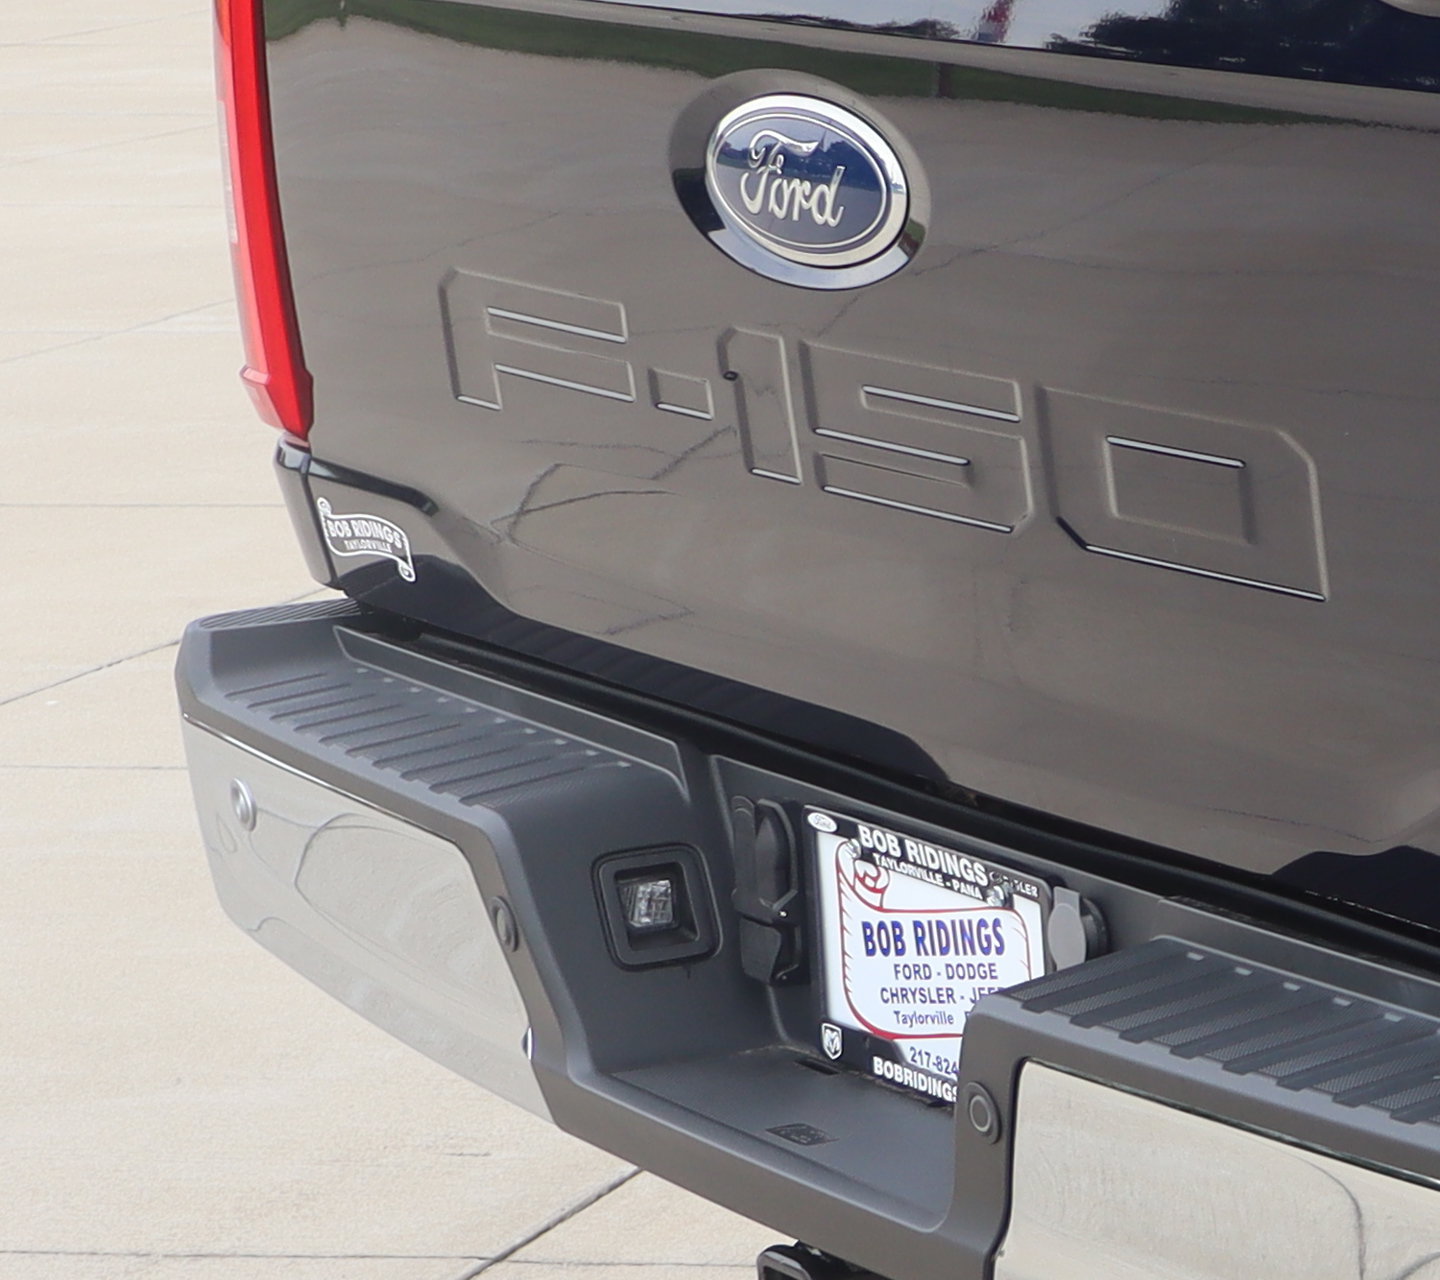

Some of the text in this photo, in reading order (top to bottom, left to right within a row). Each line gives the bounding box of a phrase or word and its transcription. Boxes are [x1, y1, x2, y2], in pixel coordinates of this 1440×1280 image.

[740, 129, 845, 227] Ford
[440, 267, 1328, 602] F-150
[326, 519, 402, 548] BOB RIDINGS
[344, 539, 392, 553] TAYLORVILLE
[857, 824, 901, 856] BOB
[905, 839, 988, 887] RIDINGS
[873, 853, 945, 887] TAYLORVILLE
[952, 878, 983, 900] PANA
[861, 918, 1005, 957] BOB RIDINGS
[894, 963, 932, 981] FORD
[945, 963, 998, 980] DODGE
[880, 987, 957, 1004] CHRYSLER
[893, 1010, 954, 1028] Taylorville
